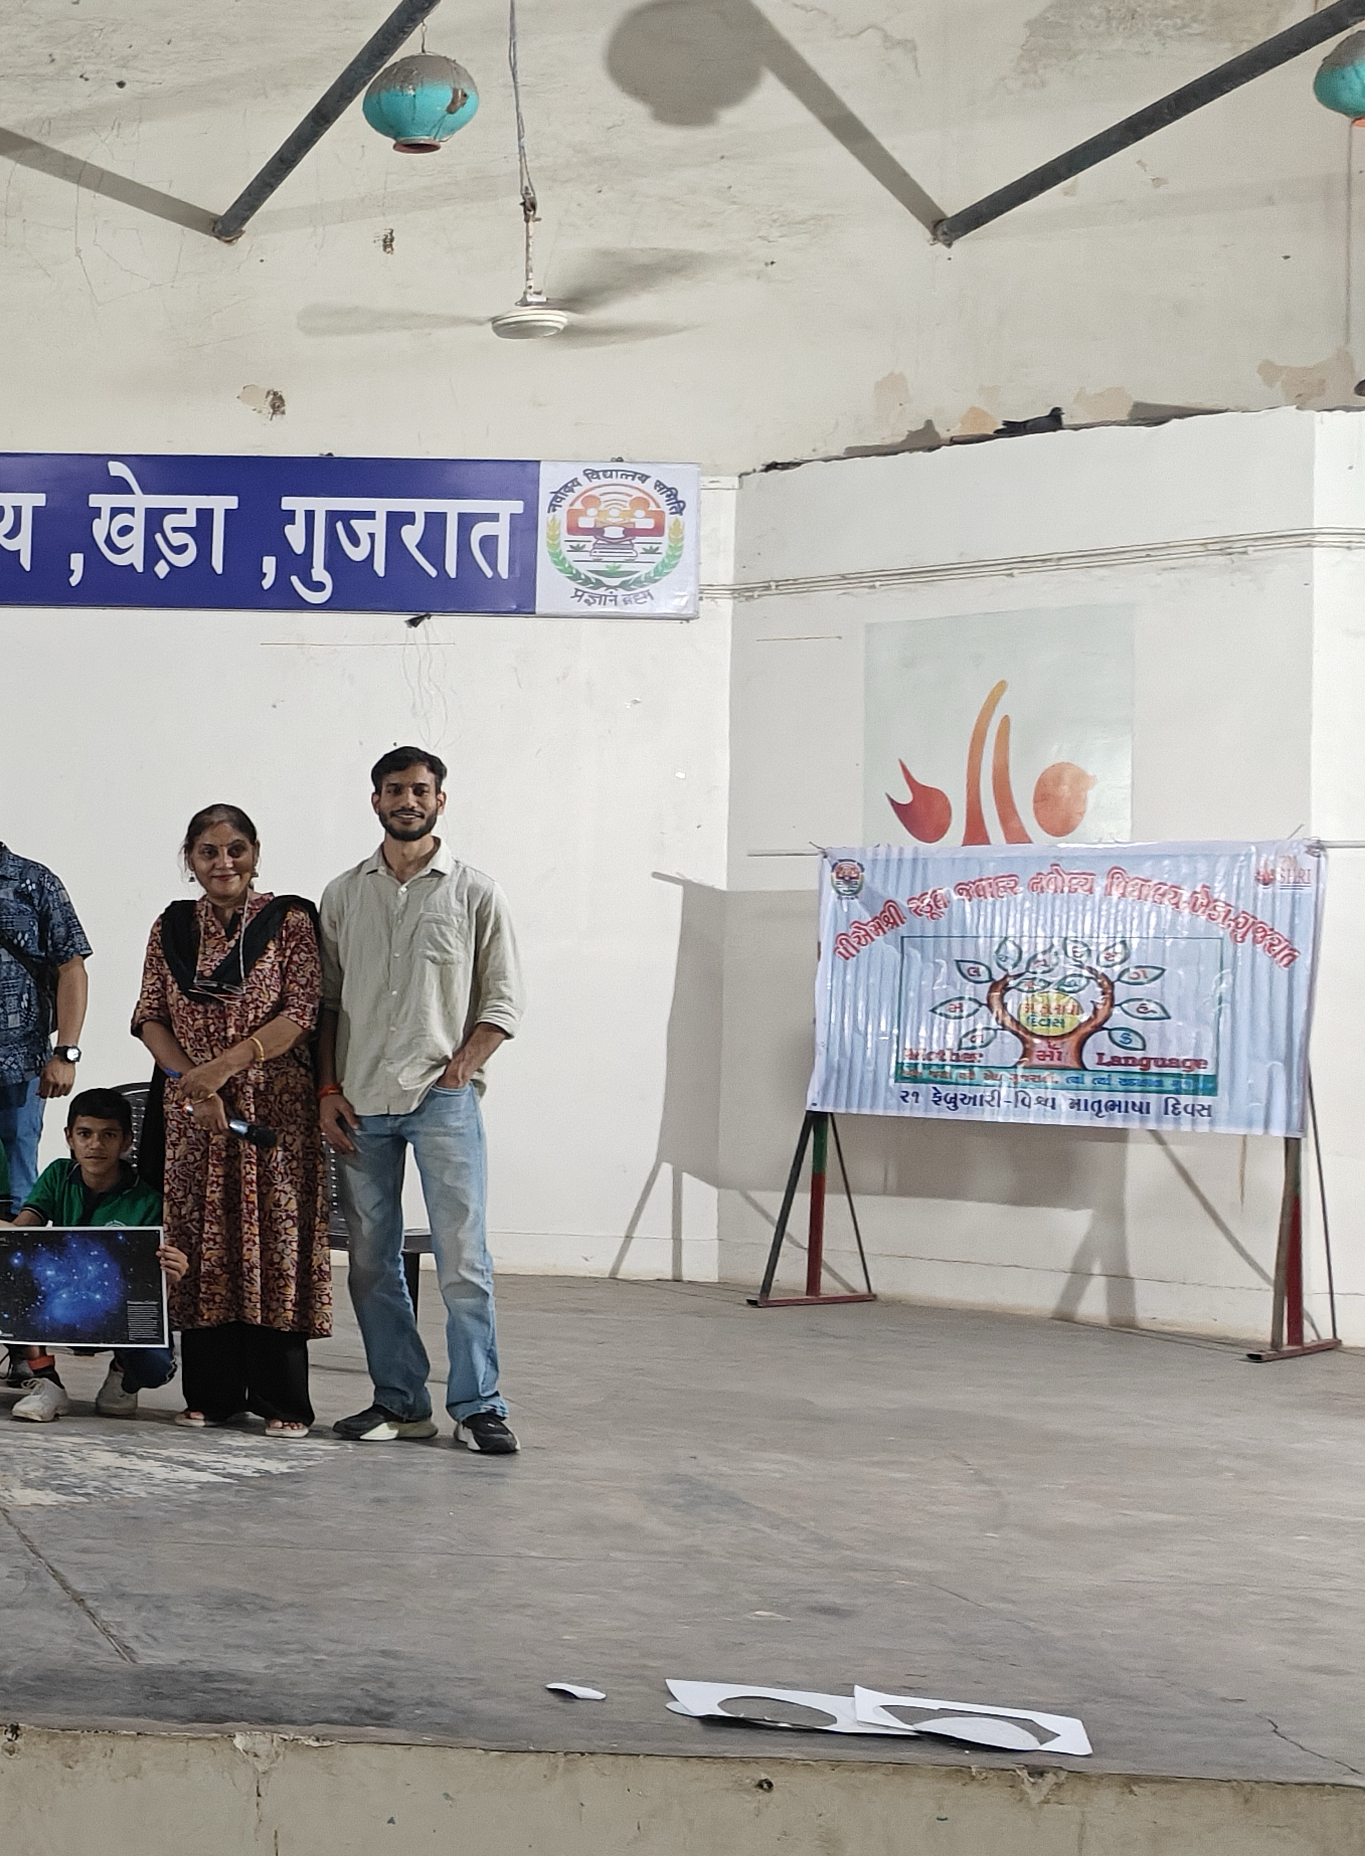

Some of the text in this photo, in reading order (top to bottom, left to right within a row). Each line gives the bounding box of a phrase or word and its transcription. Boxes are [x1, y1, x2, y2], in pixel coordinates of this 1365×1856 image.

[654, 479, 686, 516] समिति
[1095, 1052, 1209, 1072] Language
[1068, 1096, 1151, 1118] માતૃભાષા
[1163, 1096, 1212, 1118] દિવસ
